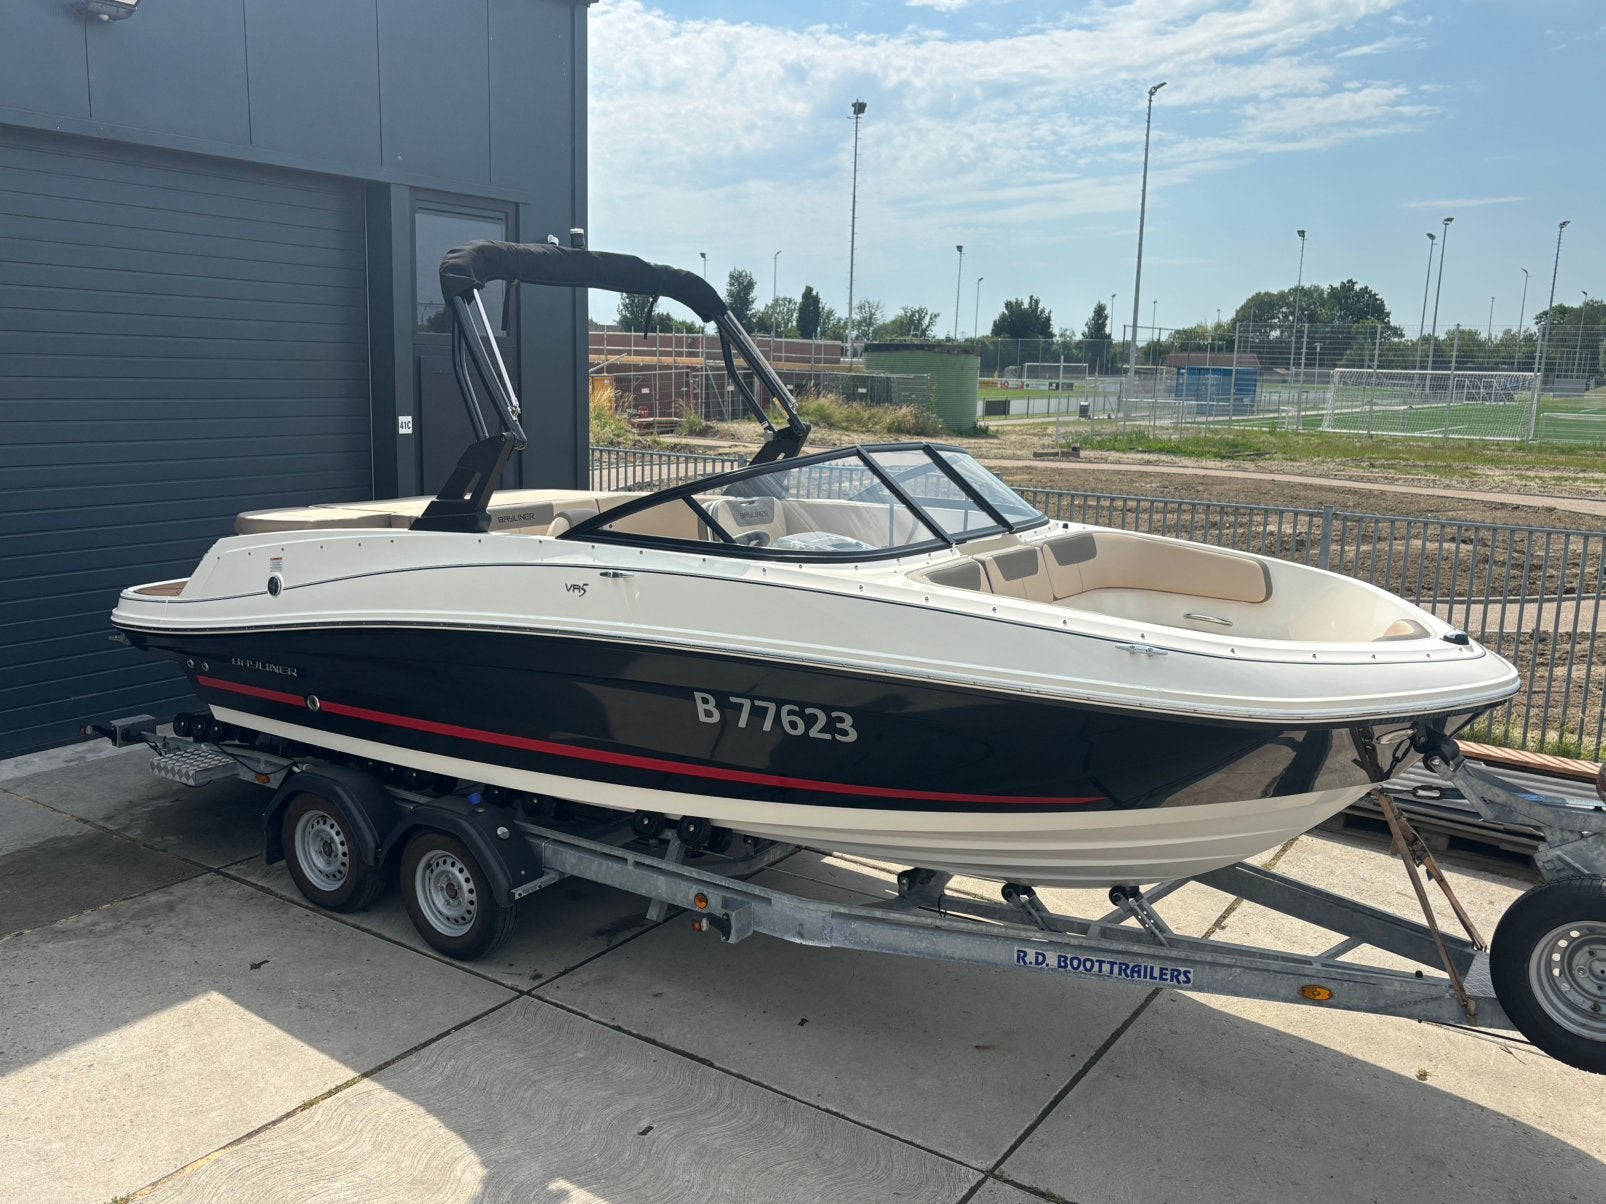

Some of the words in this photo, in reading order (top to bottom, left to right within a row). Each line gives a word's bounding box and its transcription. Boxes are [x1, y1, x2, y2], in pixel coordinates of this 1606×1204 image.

[399, 420, 411, 430] 41C
[497, 512, 535, 523] BAYLINER
[564, 582, 589, 598] VR5
[231, 657, 298, 677] BAYLINER
[693, 691, 721, 724] B
[729, 696, 858, 743] 77623
[1016, 949, 1050, 967] R.D.
[1057, 954, 1192, 985] BOOTTRAILERS
